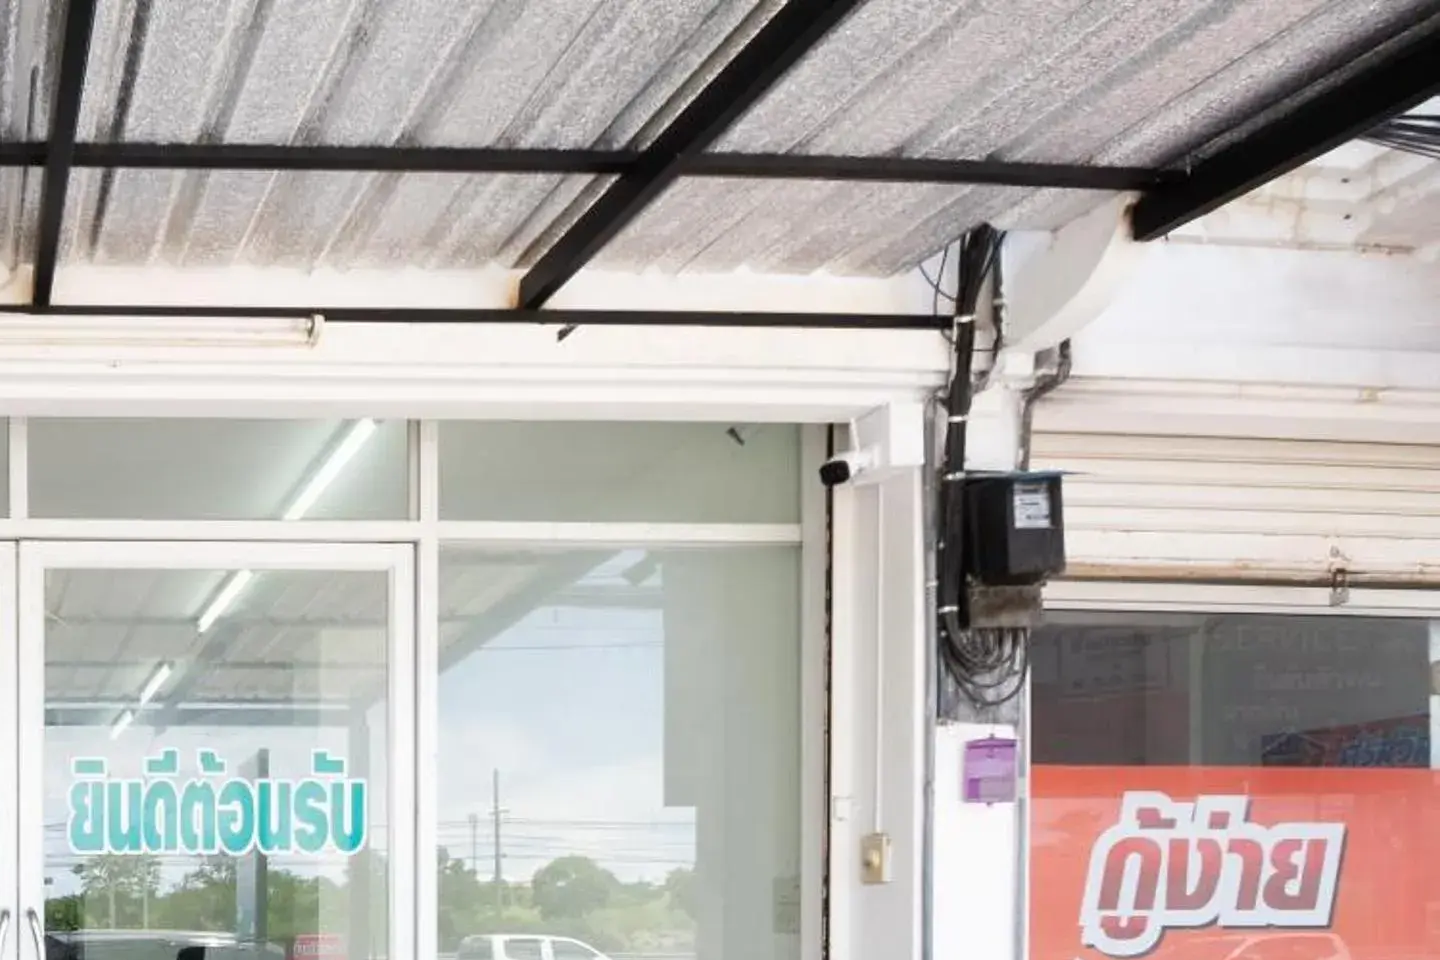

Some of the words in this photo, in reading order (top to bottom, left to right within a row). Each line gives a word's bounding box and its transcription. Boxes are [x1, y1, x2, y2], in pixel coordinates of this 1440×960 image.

[68, 749, 366, 854] ยินดีต้อนรับ
[1086, 799, 1338, 947] กู้ง่าย
